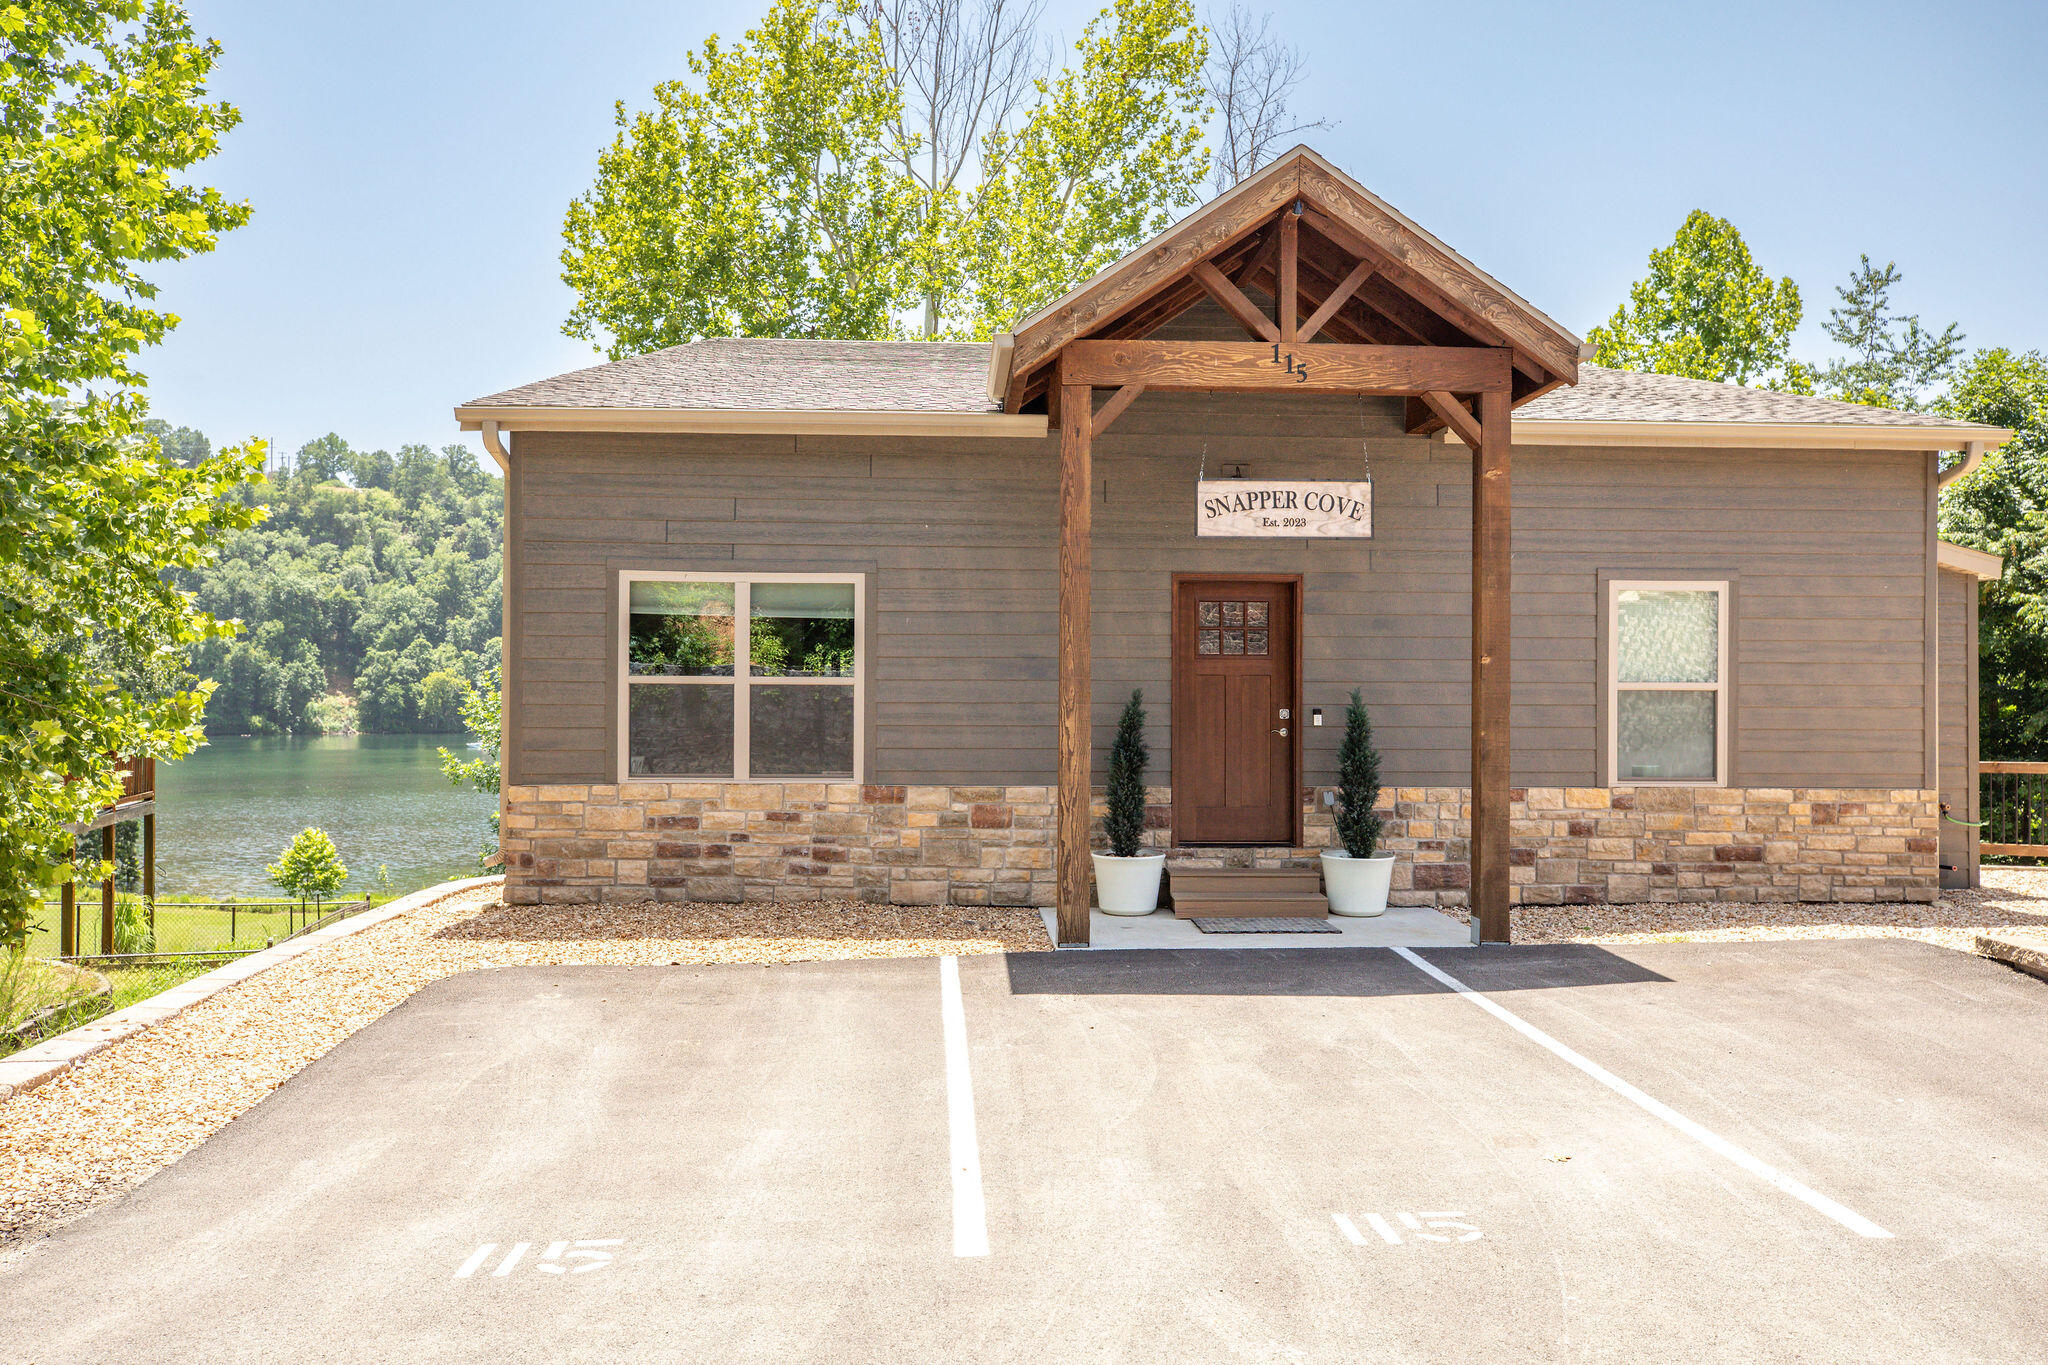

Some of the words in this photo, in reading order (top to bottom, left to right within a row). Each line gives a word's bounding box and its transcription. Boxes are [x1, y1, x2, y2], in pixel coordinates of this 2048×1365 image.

[1271, 343, 1308, 383] 115
[1204, 490, 1299, 519] SNAPPER
[1304, 491, 1365, 521] COVE
[1262, 517, 1280, 527] Est.
[1283, 517, 1307, 527] 2023
[1331, 1211, 1484, 1246] 115
[452, 1238, 625, 1278] 115
